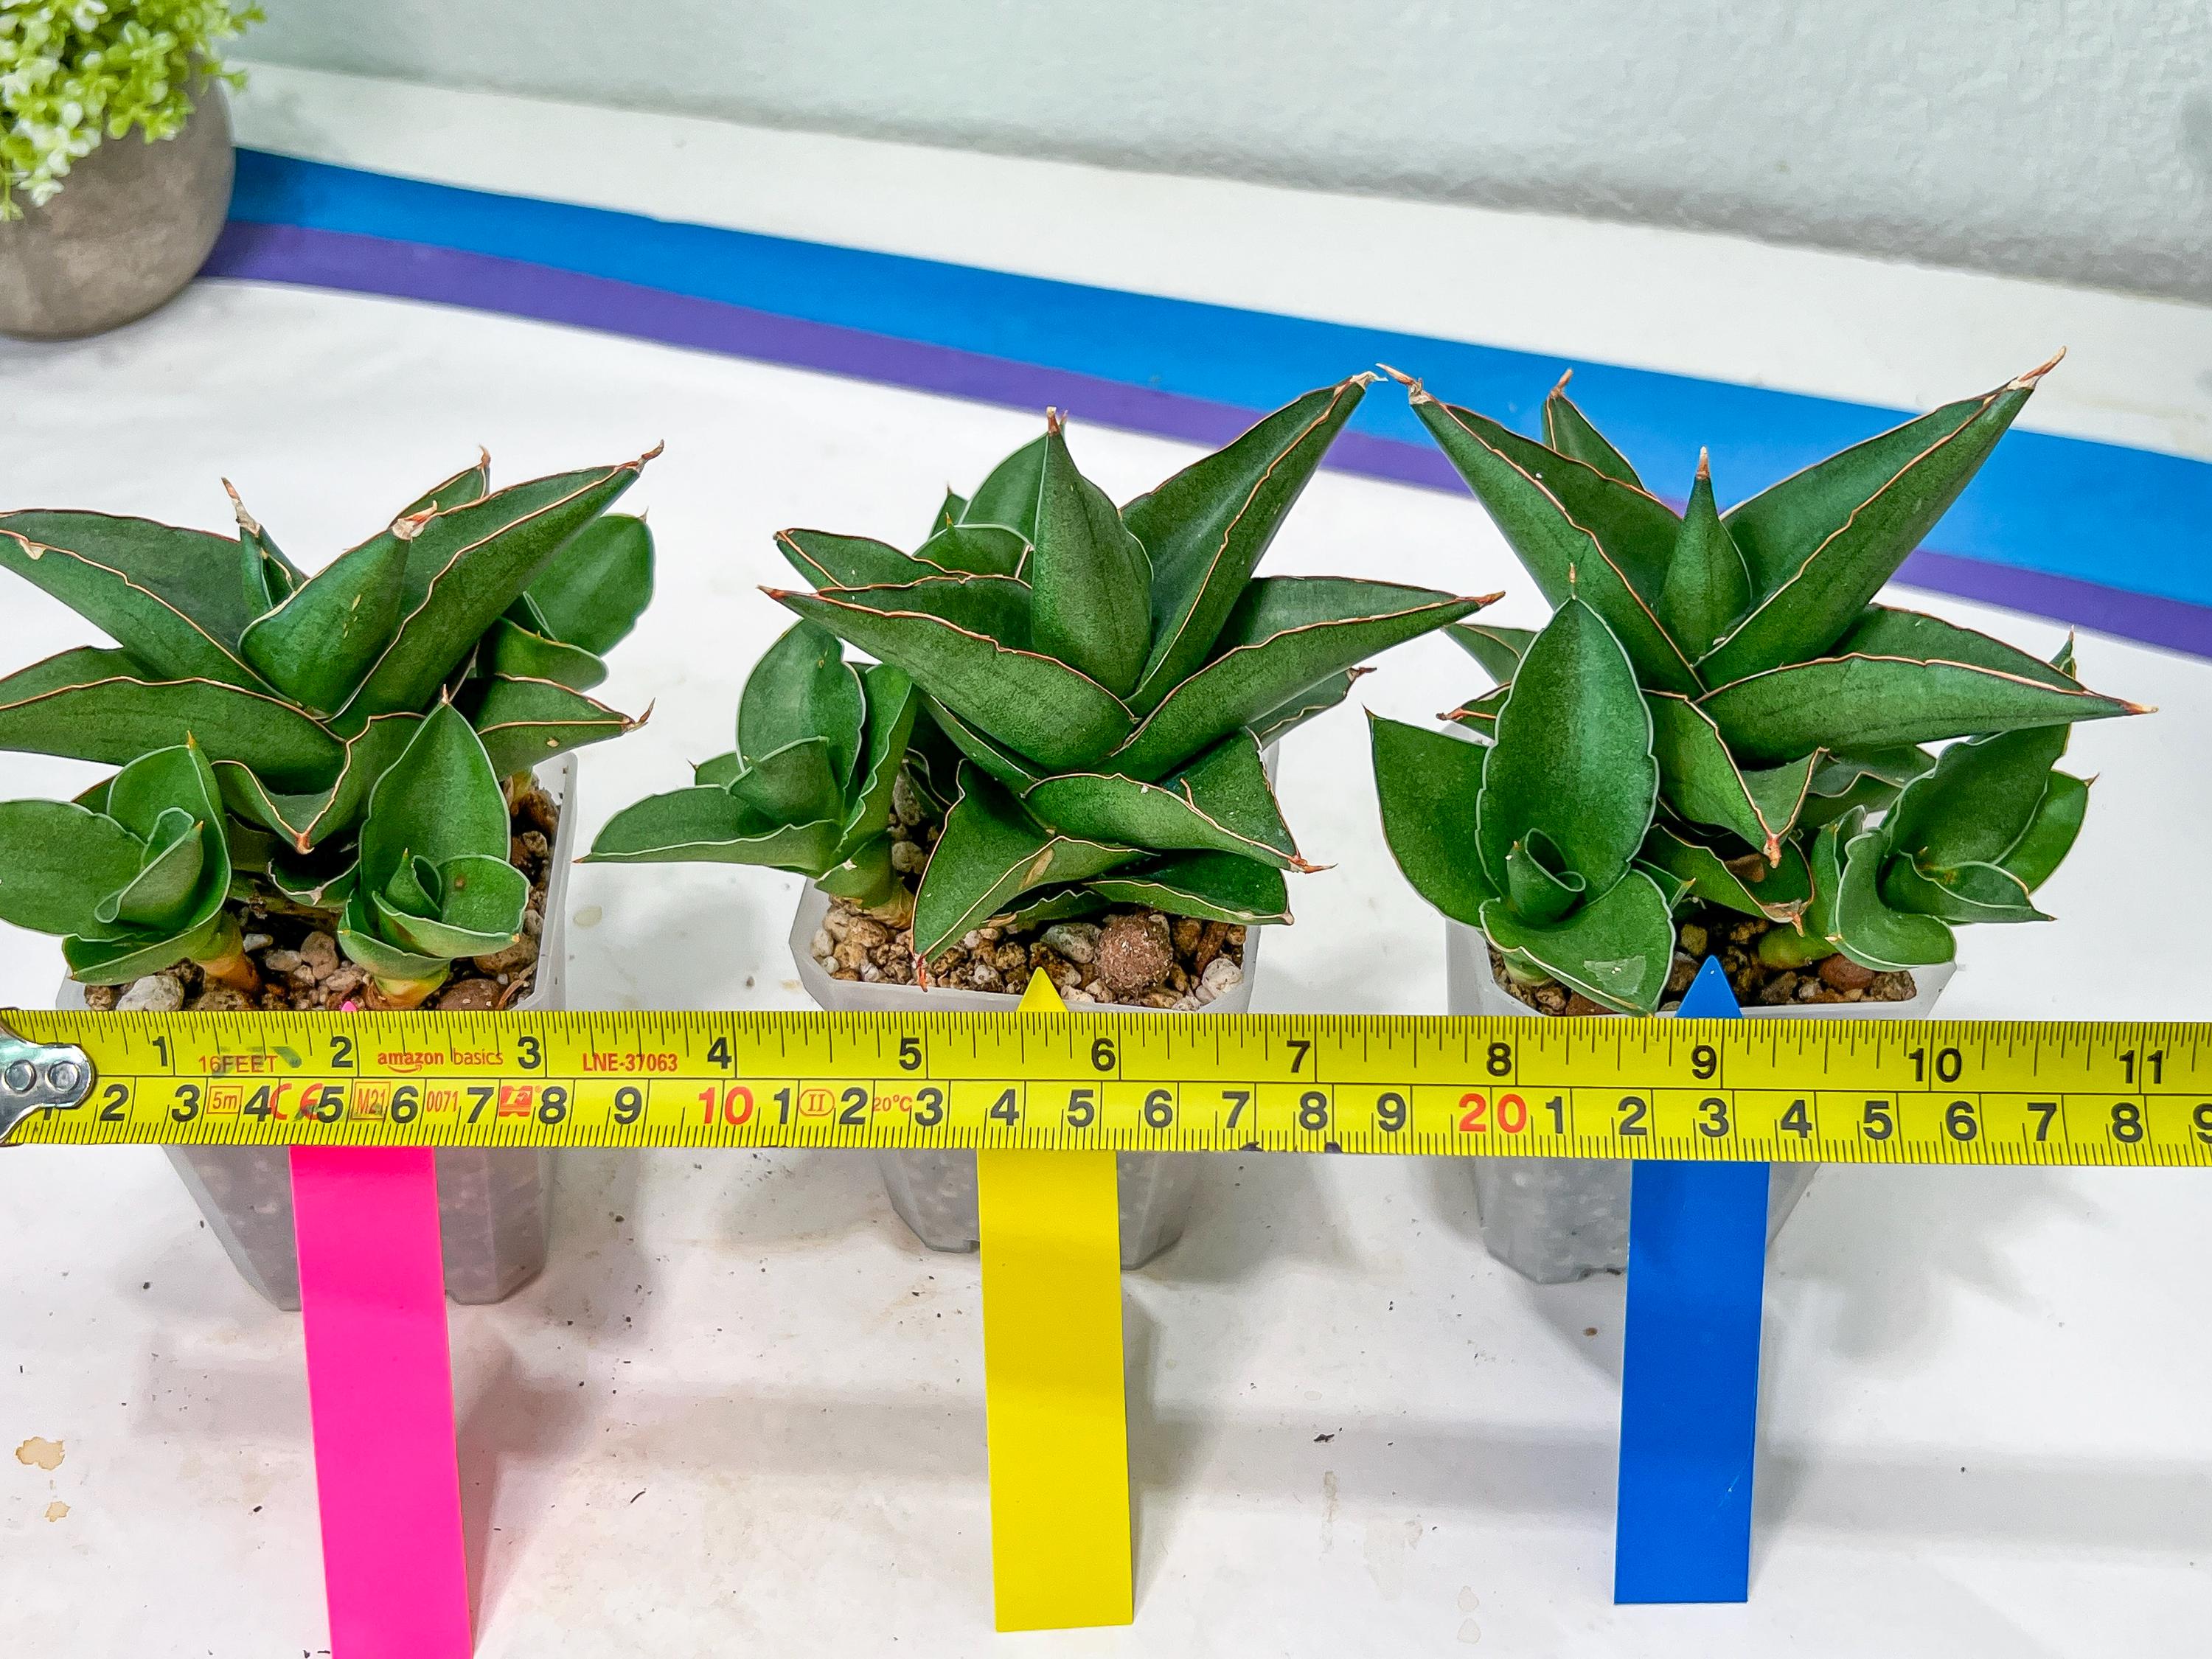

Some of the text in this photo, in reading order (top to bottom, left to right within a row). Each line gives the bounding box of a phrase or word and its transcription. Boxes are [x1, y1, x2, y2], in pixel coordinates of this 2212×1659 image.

[152, 1036, 169, 1066] 1
[199, 1055, 277, 1073] 16FEET
[330, 1037, 354, 1068] 2
[378, 1048, 503, 1065] amazon basics
[518, 1037, 542, 1068] 3
[582, 1053, 678, 1072] LNE-37063
[707, 1037, 732, 1069] 4
[899, 1037, 922, 1070] 5
[1091, 1039, 1115, 1071] 6
[1287, 1040, 1311, 1073] 7
[1486, 1043, 1512, 1076] 8
[1691, 1045, 1717, 1079] 9
[1909, 1048, 1961, 1082] 10
[2119, 1050, 2163, 1083] 11
[100, 1085, 130, 1121] 2
[171, 1085, 201, 1122] 3
[212, 1091, 237, 1110] 5m
[244, 1086, 271, 1121] 4
[317, 1087, 344, 1123] 5
[392, 1086, 419, 1124] 6
[427, 1091, 458, 1112] 0071
[467, 1087, 494, 1123] 7
[538, 1087, 567, 1124] 8
[614, 1087, 642, 1124] 9
[699, 1087, 754, 1124] 10
[773, 1088, 790, 1124] 1
[840, 1088, 868, 1124] 2
[915, 1089, 943, 1126] 3
[990, 1089, 1019, 1125] 4
[1068, 1090, 1094, 1127] 5
[1144, 1091, 1173, 1127] 6
[1222, 1091, 1250, 1128] 7
[1299, 1091, 1328, 1130] 8
[1377, 1093, 1406, 1131] 9
[1459, 1094, 1526, 1133] 20
[1545, 1096, 1562, 1134] 1
[1618, 1096, 1647, 1135] 2
[1699, 1098, 1729, 1137] 3
[1781, 1099, 1812, 1138] 4
[1863, 1101, 1892, 1139] 5
[1946, 1102, 1977, 1141] 6
[2027, 1102, 2057, 1141] 7
[2112, 1103, 2143, 1143] 8
